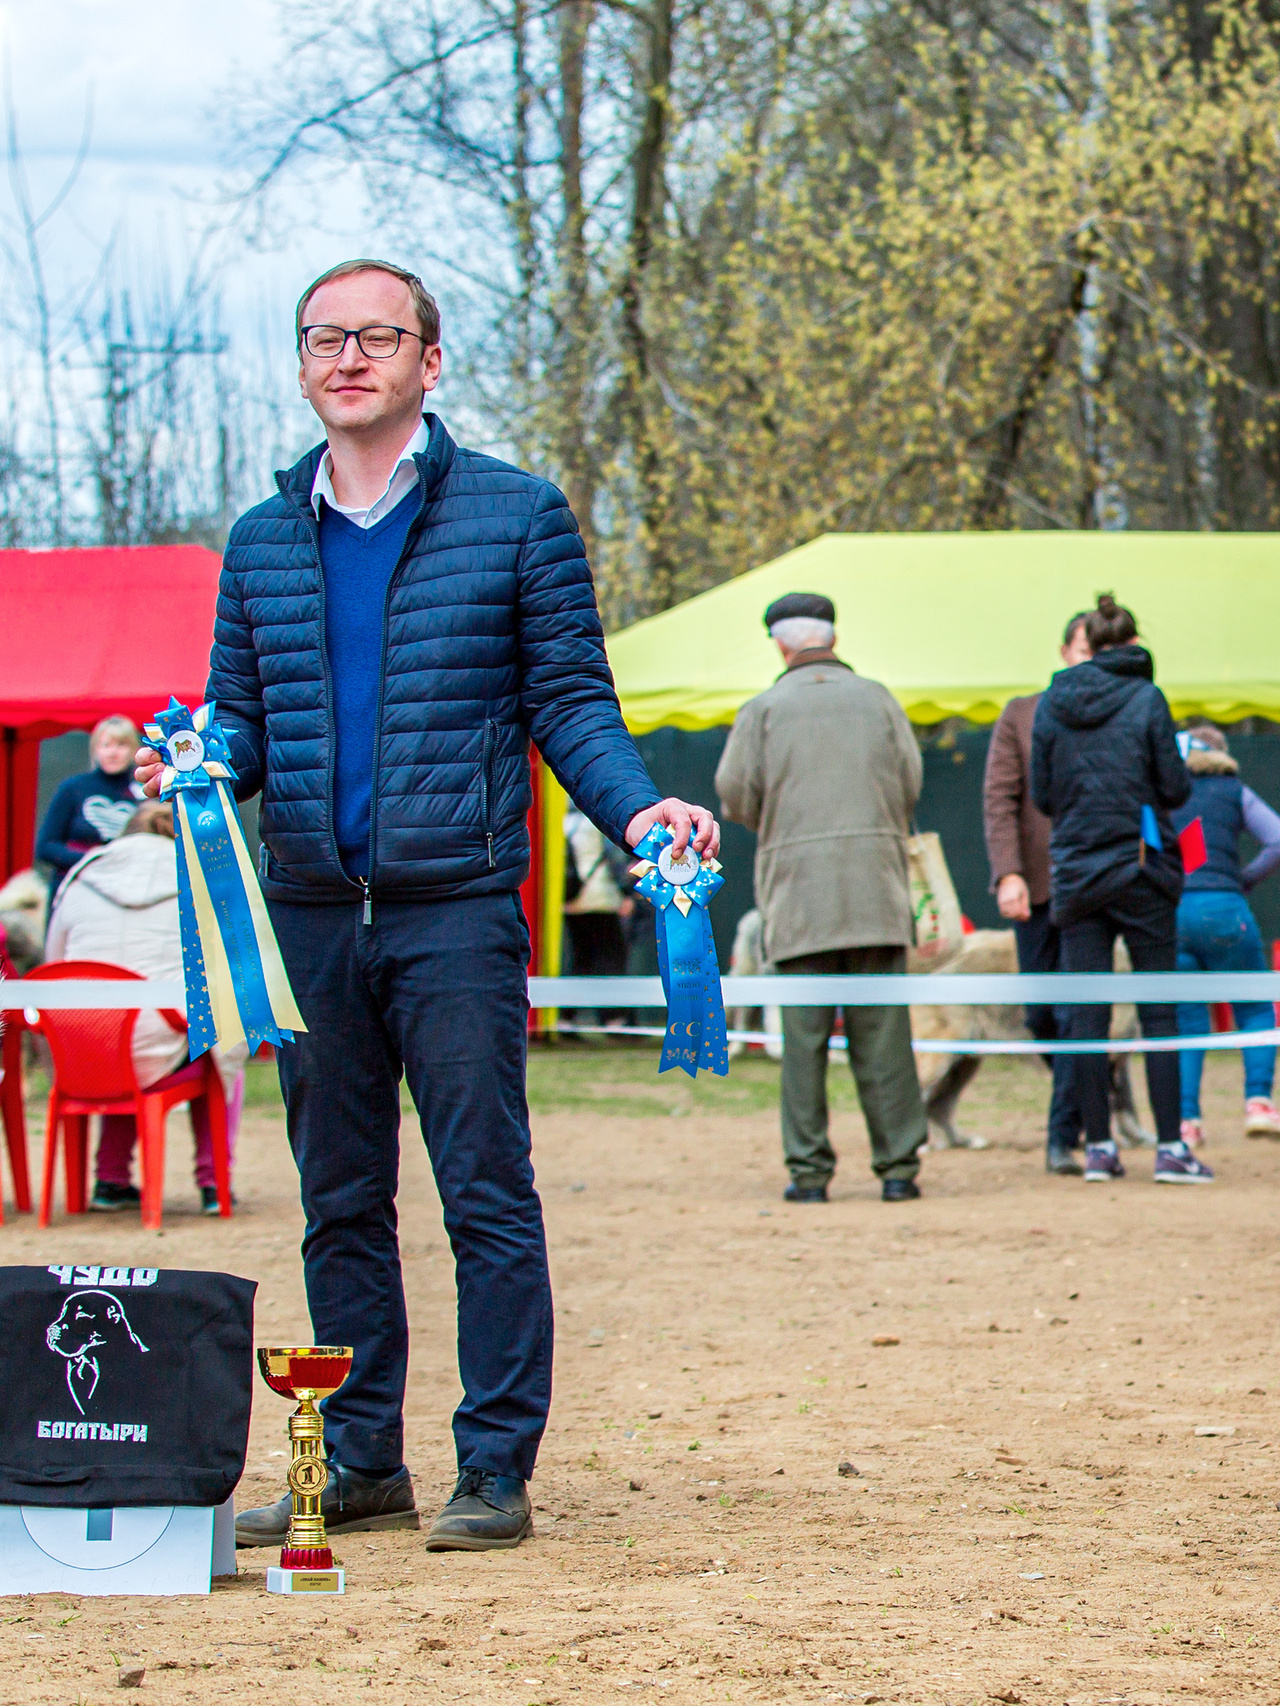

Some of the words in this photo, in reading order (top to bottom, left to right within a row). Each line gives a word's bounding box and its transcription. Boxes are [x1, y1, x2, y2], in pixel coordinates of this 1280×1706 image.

[47, 1265, 159, 1286] ЧУДО
[38, 1421, 148, 1442] БОГАТЫРИ
[301, 1465, 315, 1485] 1
